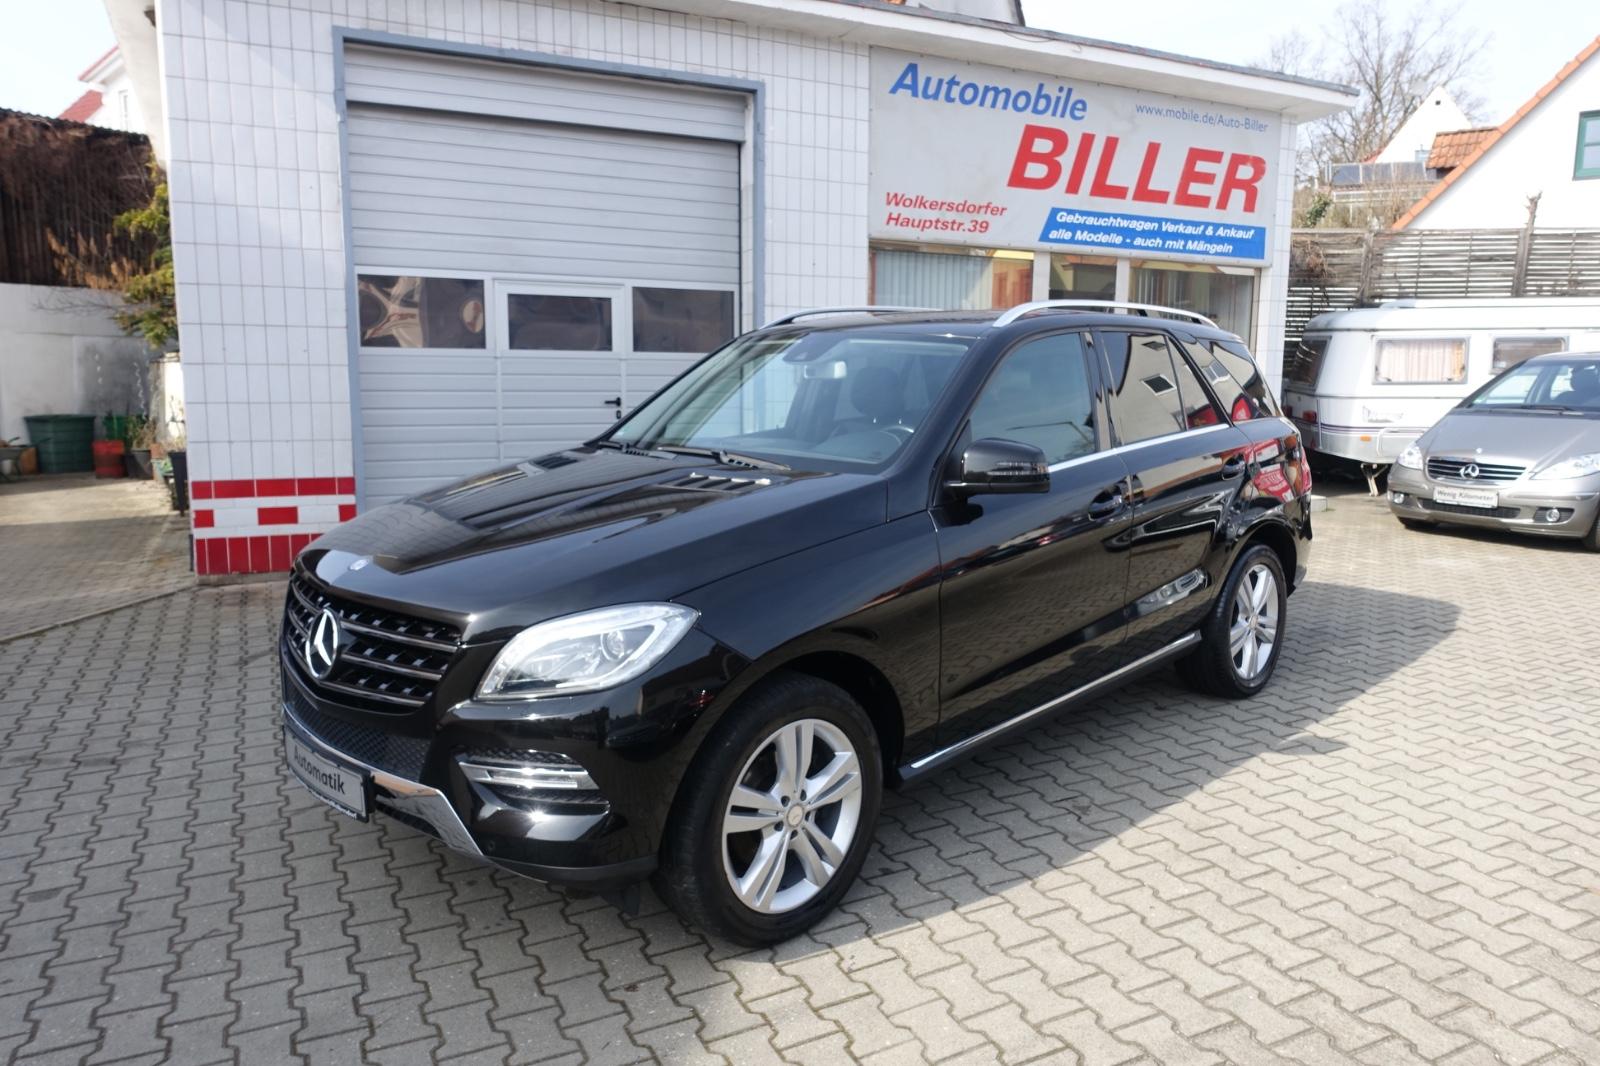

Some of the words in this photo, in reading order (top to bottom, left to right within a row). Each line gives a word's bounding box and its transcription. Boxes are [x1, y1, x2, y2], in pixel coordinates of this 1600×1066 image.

[889, 63, 1088, 121] Automobile
[1135, 104, 1268, 132] www.mobile.de/Auto-Biller
[1007, 124, 1267, 214] BILLER
[885, 191, 1007, 217] Wolkersdorfer
[885, 213, 990, 233] Hauptstr.39
[1056, 211, 1159, 232] Gebrauchtwagen
[1162, 220, 1204, 236] Verkauf
[1206, 226, 1215, 237] &
[1215, 227, 1255, 240] Ankauf
[1049, 229, 1073, 240] alle
[1075, 231, 1123, 245] Modelle
[1133, 236, 1162, 248] auch
[1165, 239, 1185, 250] mit
[1187, 241, 1234, 254] Mängeln
[1437, 489, 1457, 500] Wenig
[293, 745, 345, 795] Automatik
